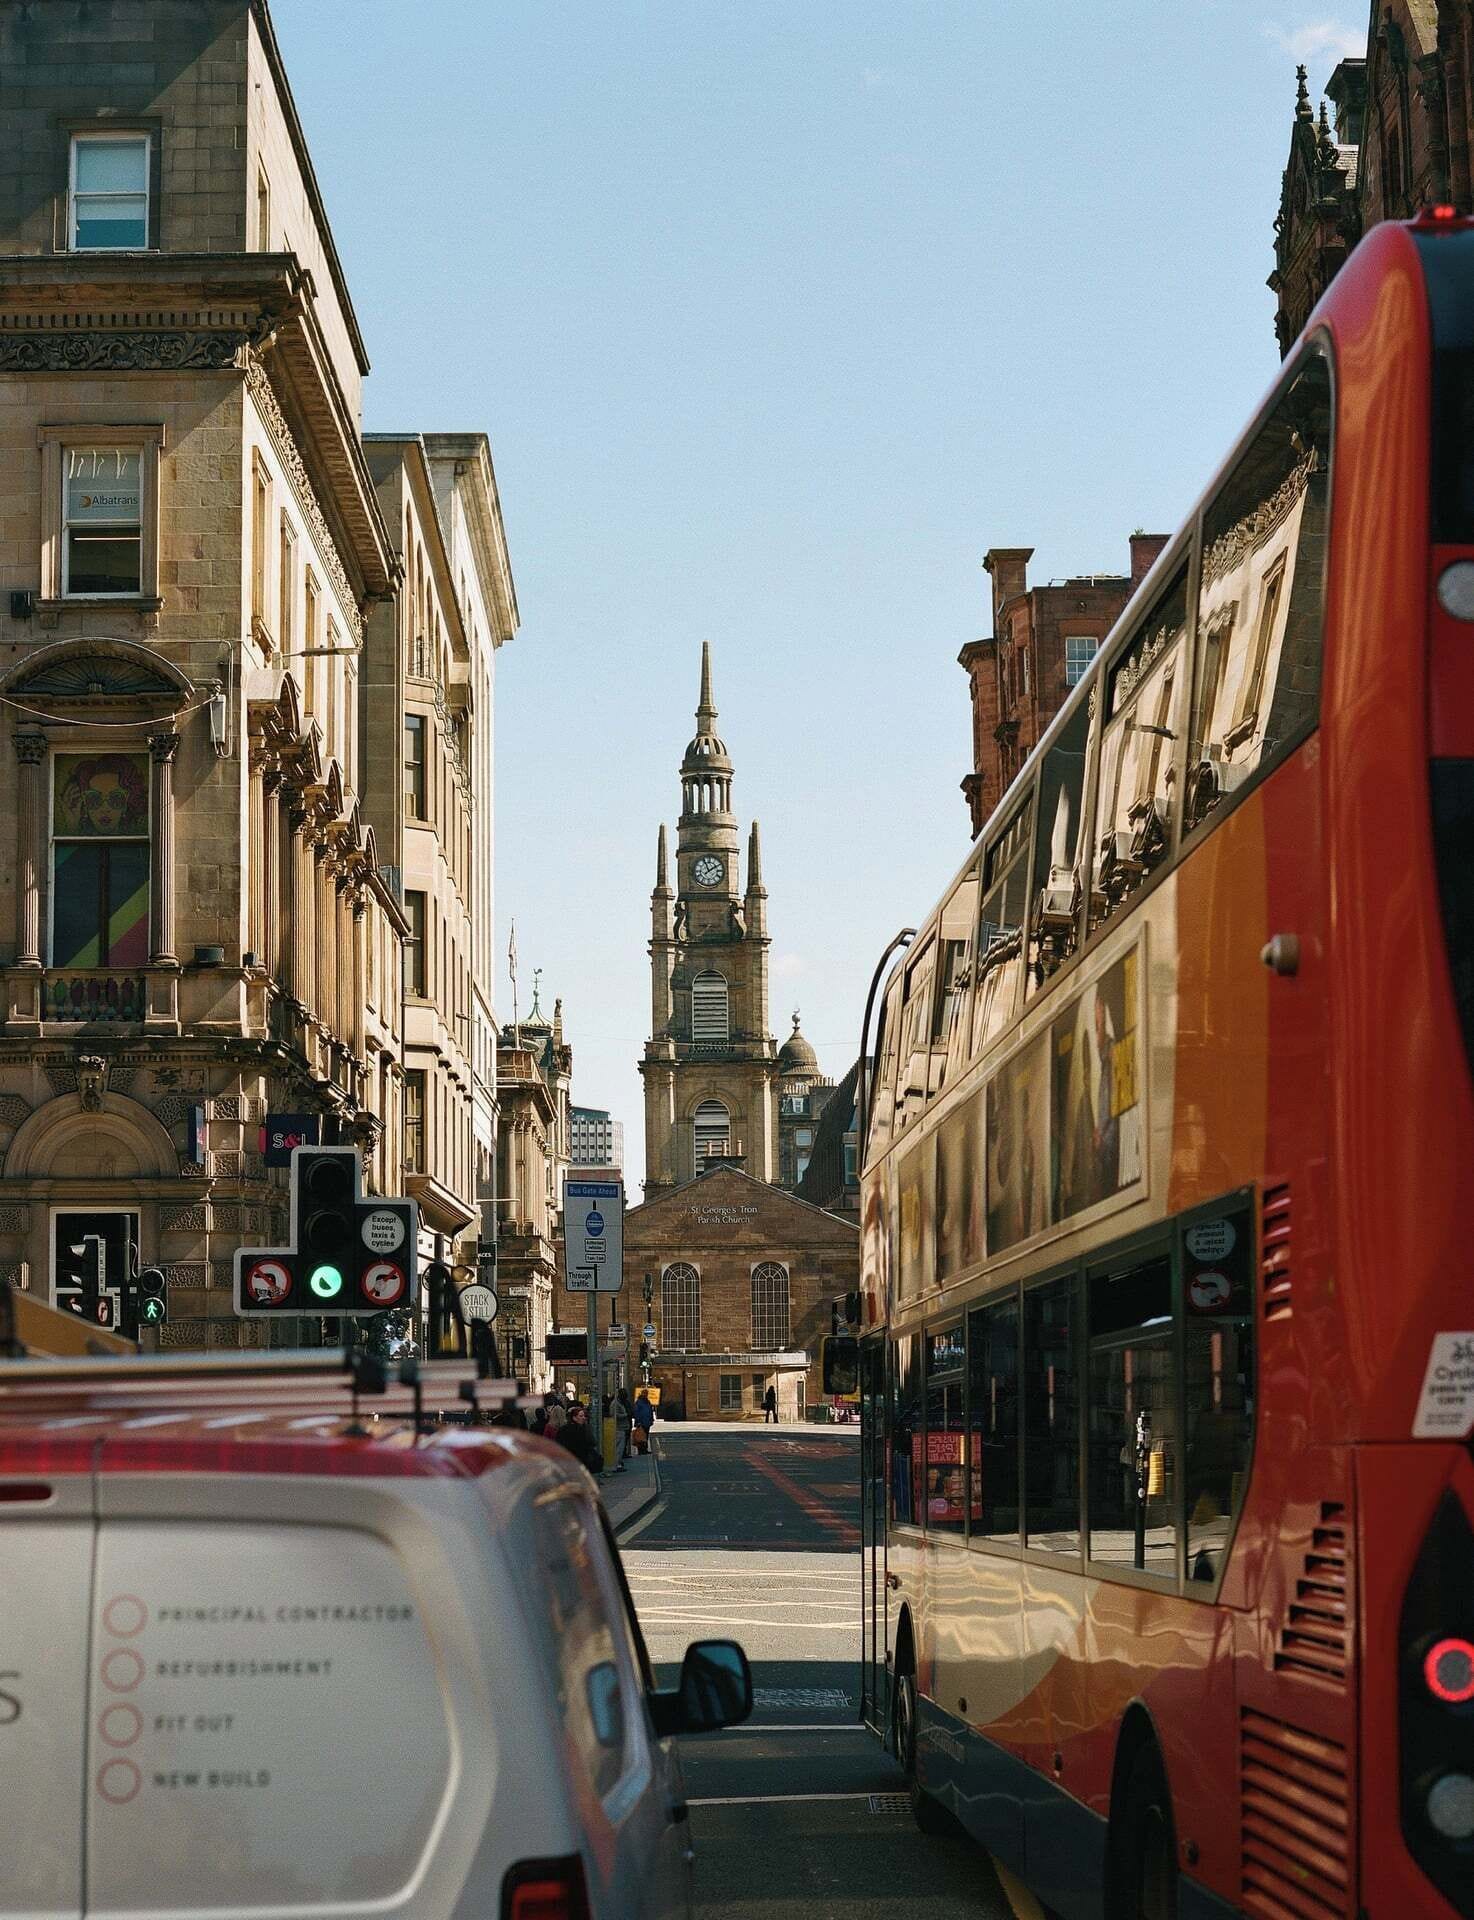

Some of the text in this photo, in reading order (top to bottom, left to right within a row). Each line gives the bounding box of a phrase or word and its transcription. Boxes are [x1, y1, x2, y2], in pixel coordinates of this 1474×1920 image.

[92, 495, 138, 505] Albatrans
[740, 1205, 758, 1213] Tron
[697, 1216, 750, 1224] Parish Church
[371, 1224, 396, 1232] buses,
[568, 1271, 592, 1281] Through
[571, 1280, 590, 1288] traffic
[464, 1294, 489, 1306] STACK
[468, 1306, 490, 1318] STILL
[157, 1604, 414, 1623] PRINCIPAL CONTRACTOR
[156, 1660, 333, 1676] REFURBISHMENT
[153, 1713, 234, 1731] FIT OUT
[152, 1770, 272, 1788] NEW BUILD
